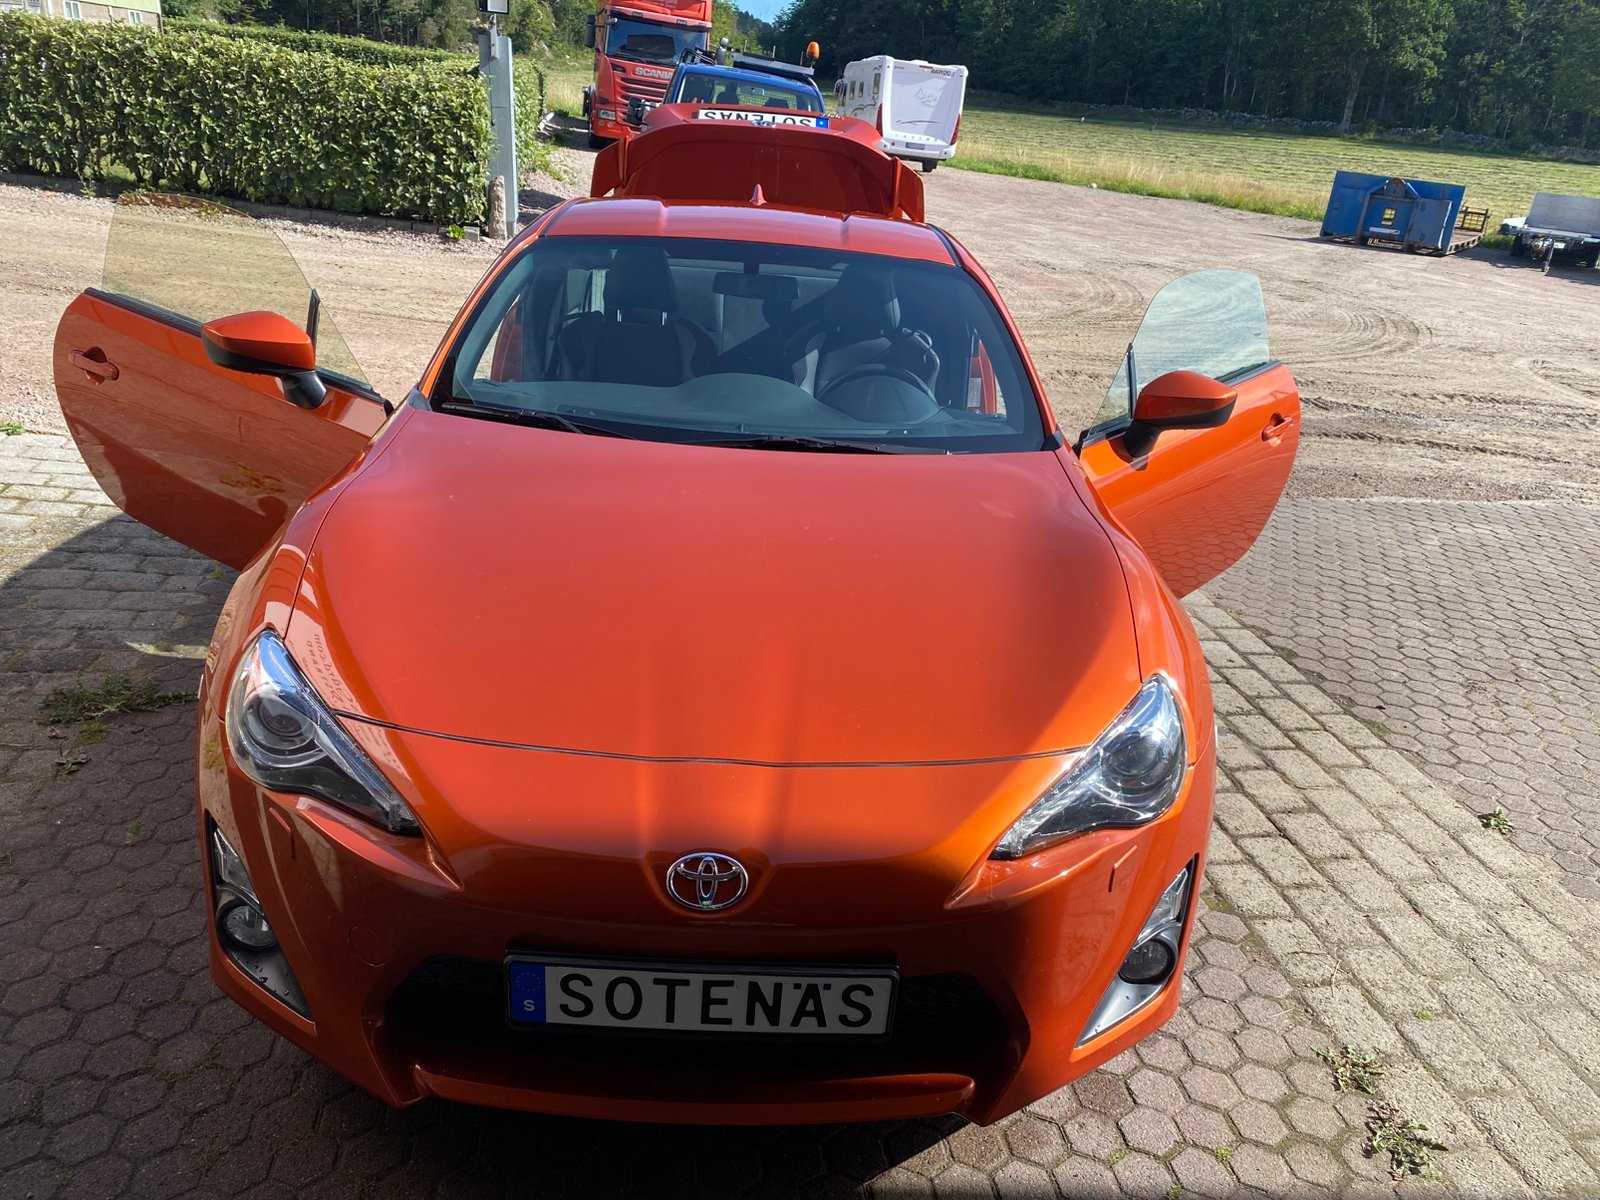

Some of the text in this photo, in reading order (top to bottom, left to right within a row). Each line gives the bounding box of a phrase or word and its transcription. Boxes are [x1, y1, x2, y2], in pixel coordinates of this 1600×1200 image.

[635, 67, 674, 80] SCANIA
[523, 999, 535, 1012] S
[558, 973, 875, 1028] SOTENÄS
